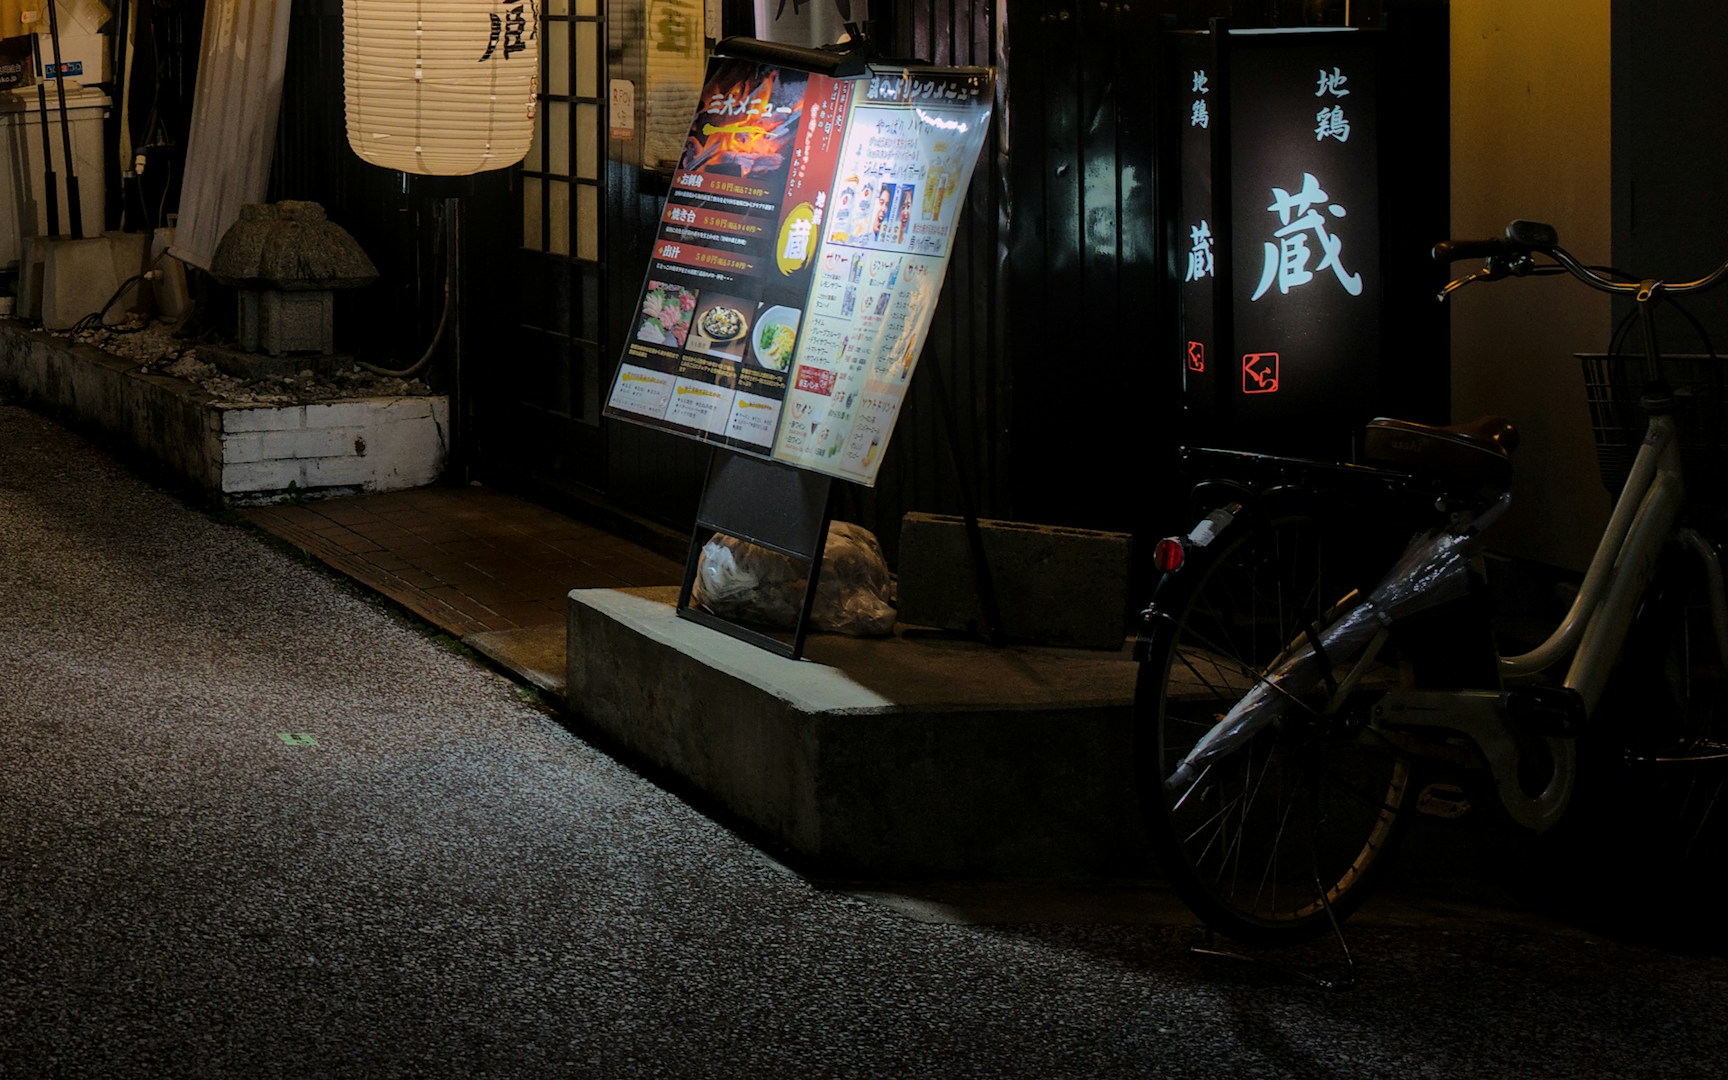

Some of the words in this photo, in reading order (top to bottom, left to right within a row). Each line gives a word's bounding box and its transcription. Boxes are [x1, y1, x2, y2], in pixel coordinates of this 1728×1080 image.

[1191, 70, 1209, 129] 地鶏
[1314, 67, 1350, 143] 地鶏
[1185, 220, 1215, 283] 蔵
[1250, 172, 1363, 302] 蔵
